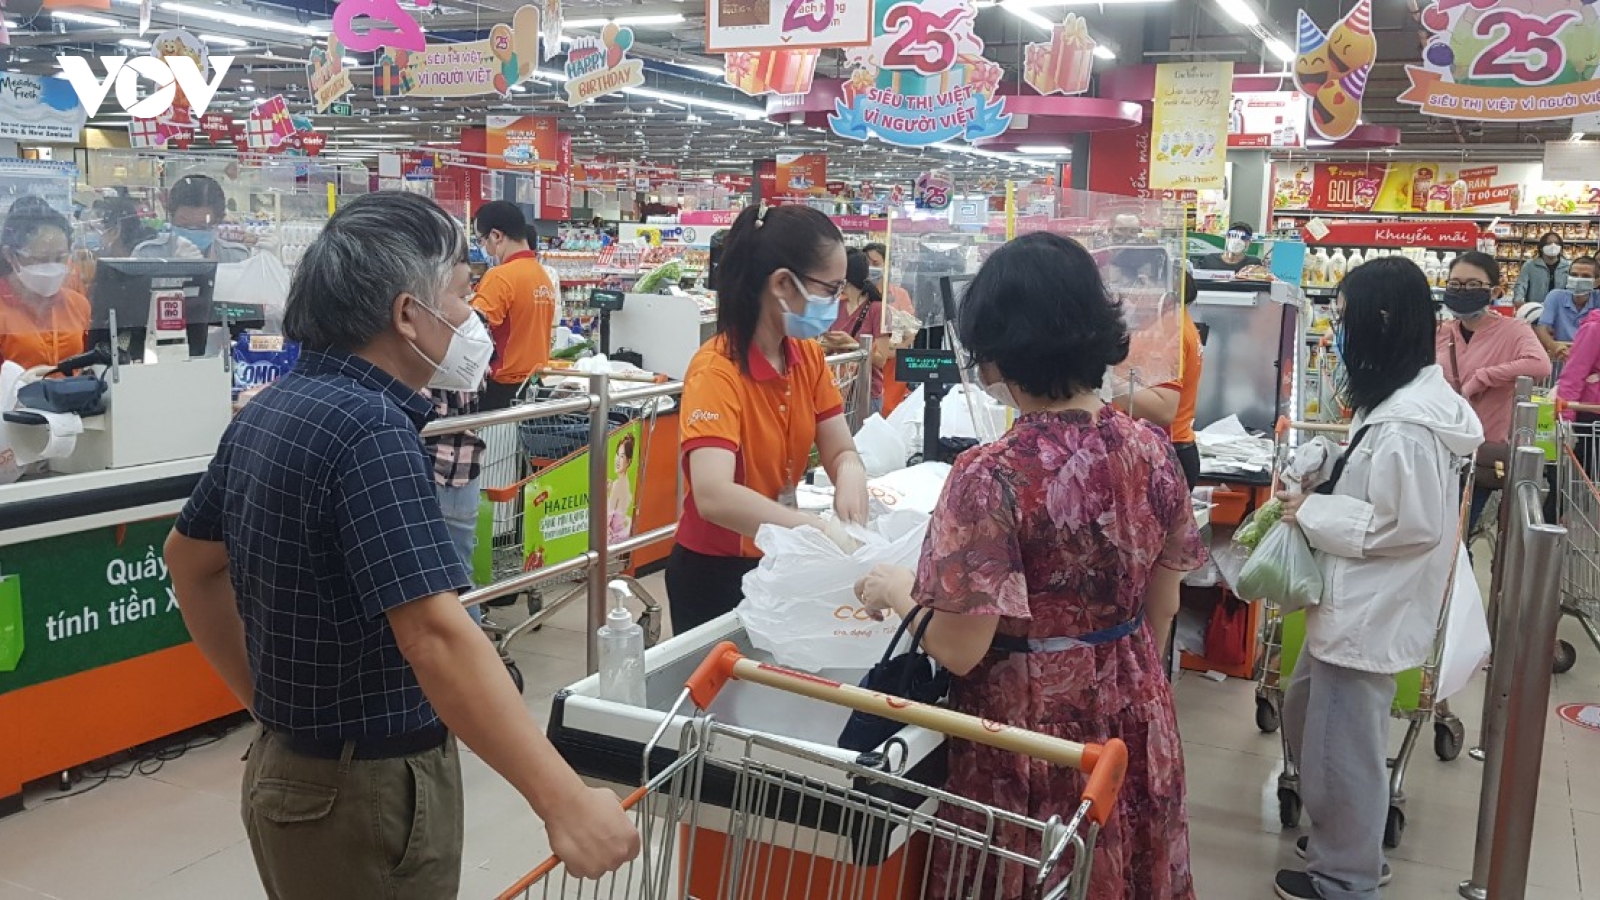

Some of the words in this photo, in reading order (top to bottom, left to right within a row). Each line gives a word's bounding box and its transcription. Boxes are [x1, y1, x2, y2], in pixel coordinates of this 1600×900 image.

[883, 6, 966, 73] 25
[1472, 11, 1578, 82] 25
[466, 67, 492, 83] VIỆT
[566, 48, 607, 79] HAPPY
[13, 86, 37, 100] Fresh
[577, 67, 631, 98] BIRTHDAY
[868, 86, 903, 108] SIÊU
[906, 96, 933, 112] THỊ
[936, 84, 973, 106] VIỆT
[1429, 93, 1457, 108] SIÊU
[1462, 99, 1481, 112] THỊ
[1487, 98, 1515, 112] VIỆT
[1522, 96, 1534, 110] VÌ
[863, 108, 880, 125] VÌ
[881, 115, 936, 132] NGƯỜI
[940, 106, 975, 128] VIỆT
[926, 186, 948, 206] 25
[1492, 188, 1509, 198] CAO
[1374, 226, 1434, 244] Khuyến
[1438, 231, 1469, 243] mãi
[243, 365, 281, 384] OMO
[106, 545, 169, 586] Quầy
[45, 605, 99, 642] tính
[107, 588, 157, 626] tiền
